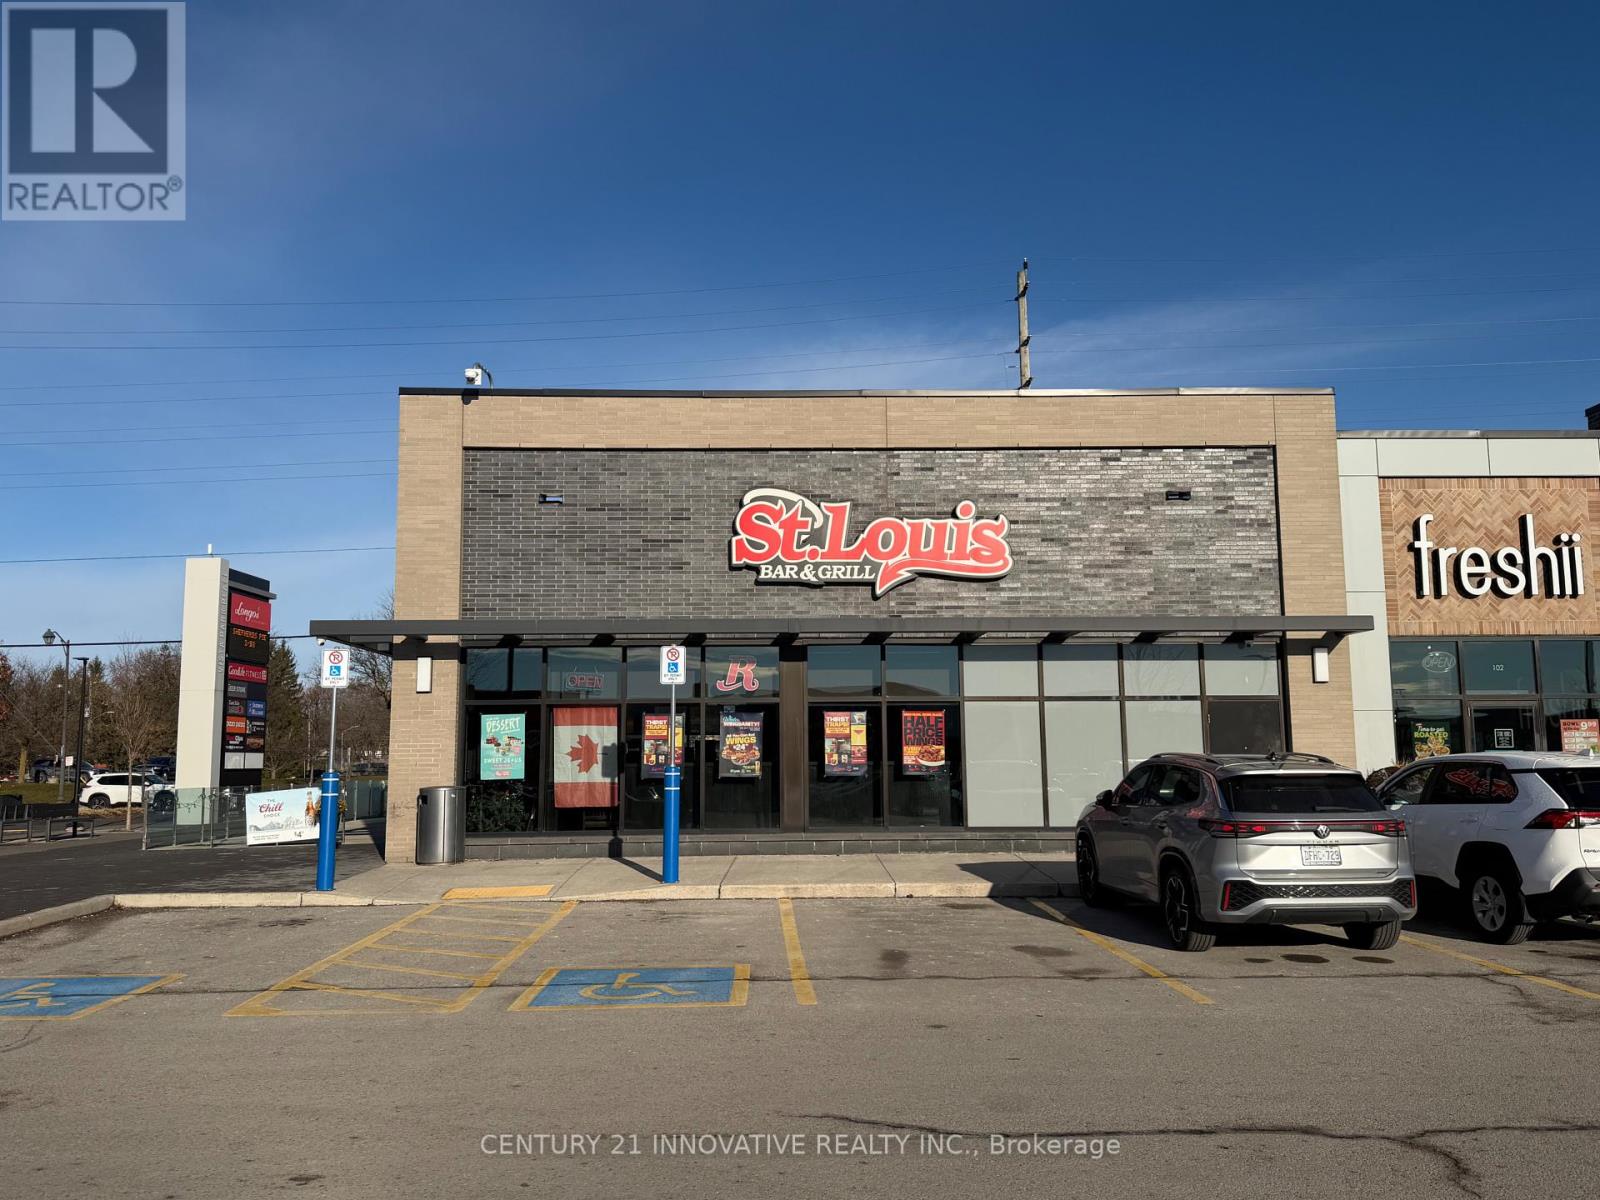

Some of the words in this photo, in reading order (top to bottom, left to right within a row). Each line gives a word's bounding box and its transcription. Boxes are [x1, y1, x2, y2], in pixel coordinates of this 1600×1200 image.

[566, 674, 603, 689] OPEN
[905, 716, 944, 728] HALF
[905, 727, 944, 738] PRICE
[1414, 731, 1448, 739] ROASTED
[725, 736, 756, 745] WINGS
[259, 802, 284, 813] Chill
